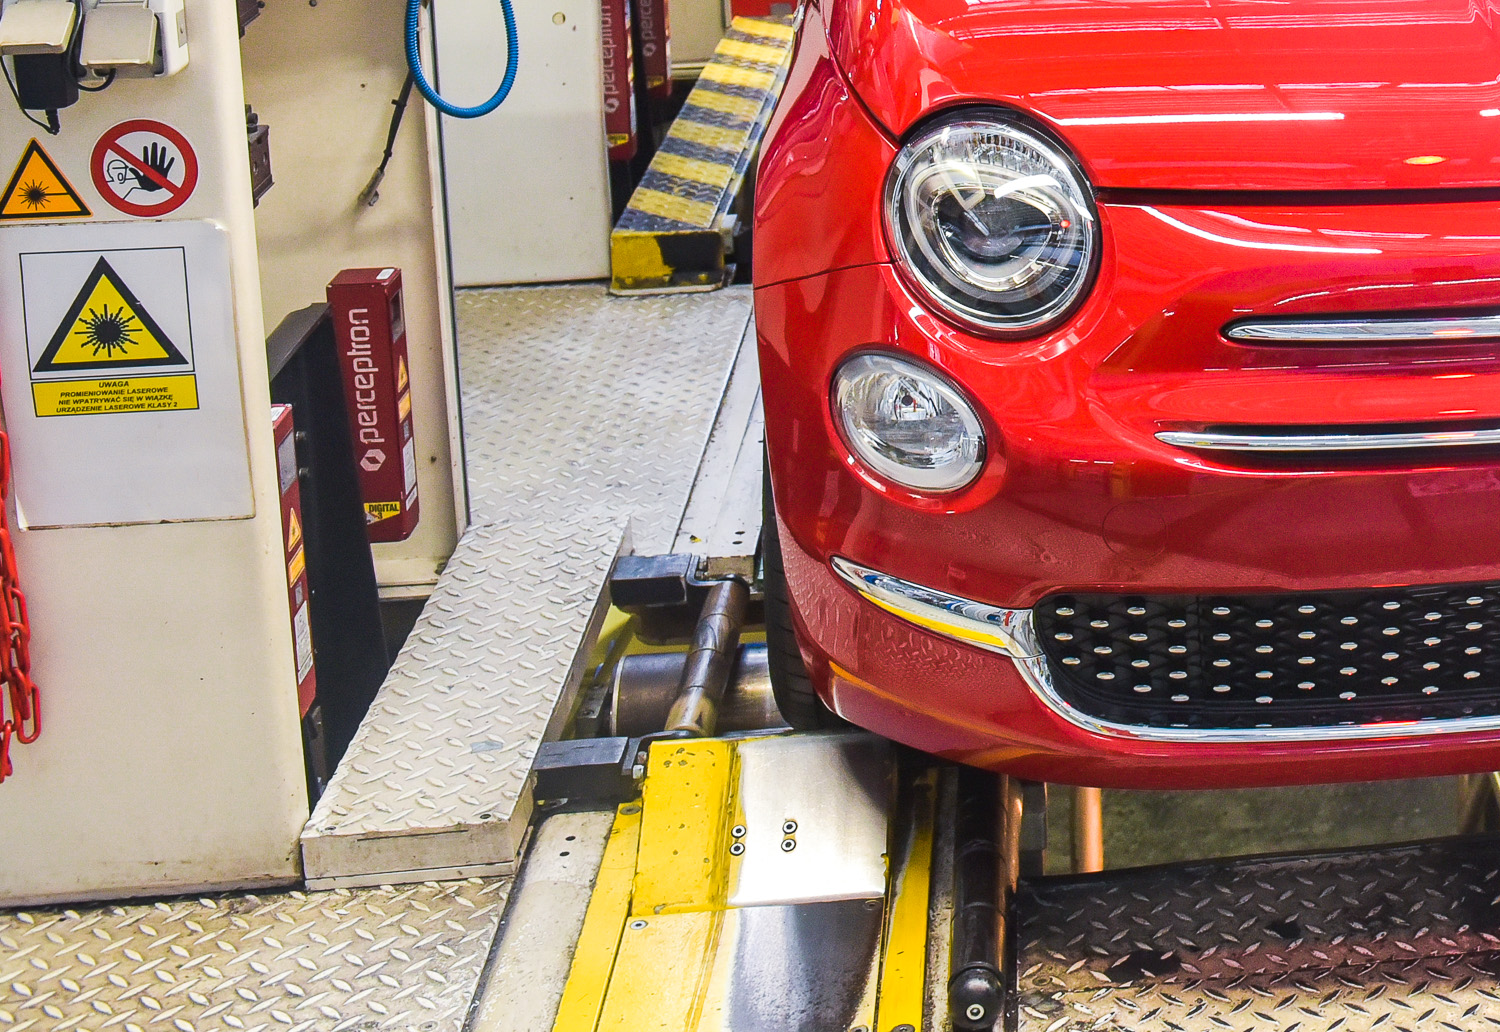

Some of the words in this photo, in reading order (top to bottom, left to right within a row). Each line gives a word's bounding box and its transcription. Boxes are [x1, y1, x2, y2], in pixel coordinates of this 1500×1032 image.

[347, 308, 385, 444] perceptron
[98, 380, 130, 388] UWAGA
[60, 389, 126, 398] PROMIENIOWANIE
[127, 387, 168, 395] LASEROWE
[72, 396, 121, 405] WPATRYWAĆ
[56, 405, 103, 413] URZĄDZENIE
[368, 503, 399, 513] DIGITAL
